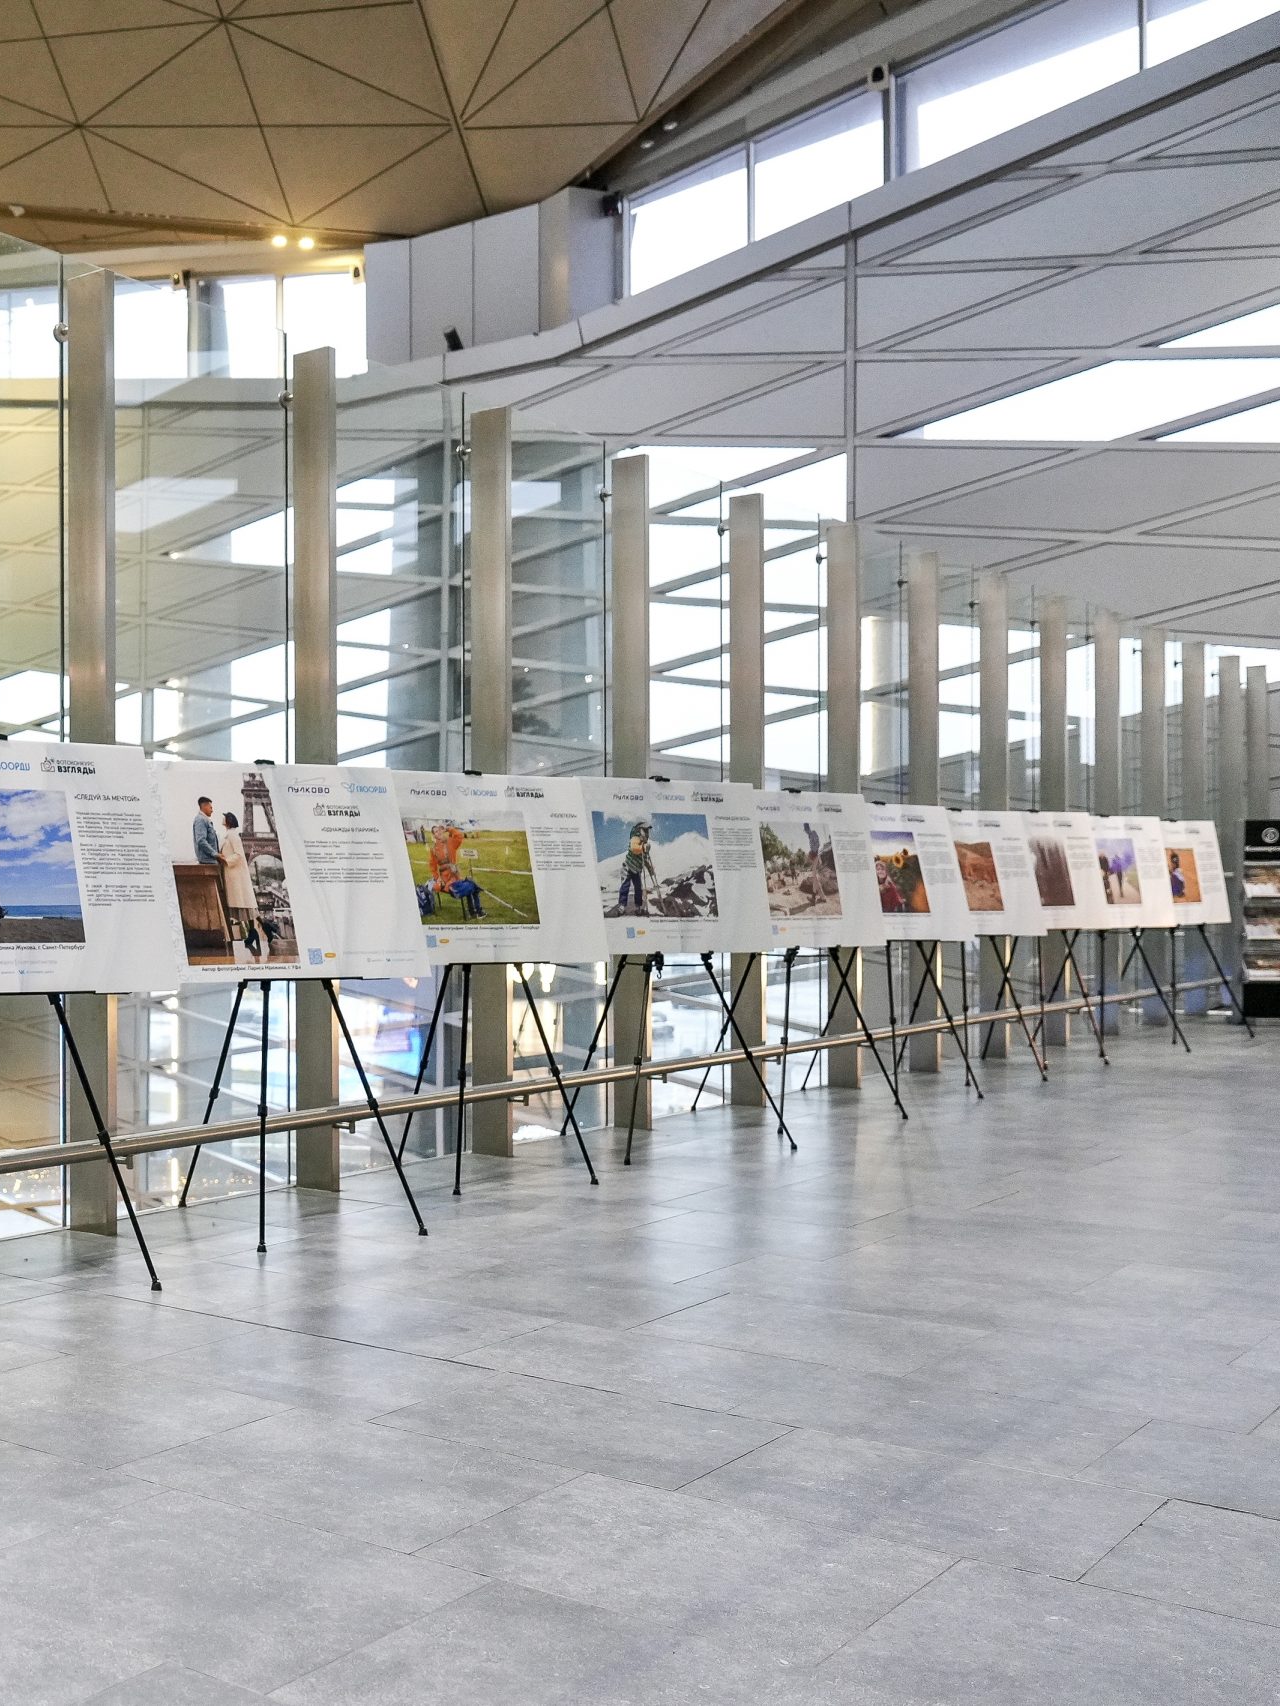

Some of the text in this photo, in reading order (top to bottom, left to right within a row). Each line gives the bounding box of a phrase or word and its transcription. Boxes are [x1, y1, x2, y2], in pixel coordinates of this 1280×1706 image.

[58, 766, 96, 774] ВЗГЛЯДЫ
[288, 786, 330, 794] ПУЛКОВО
[15, 944, 37, 952] Жукова,
